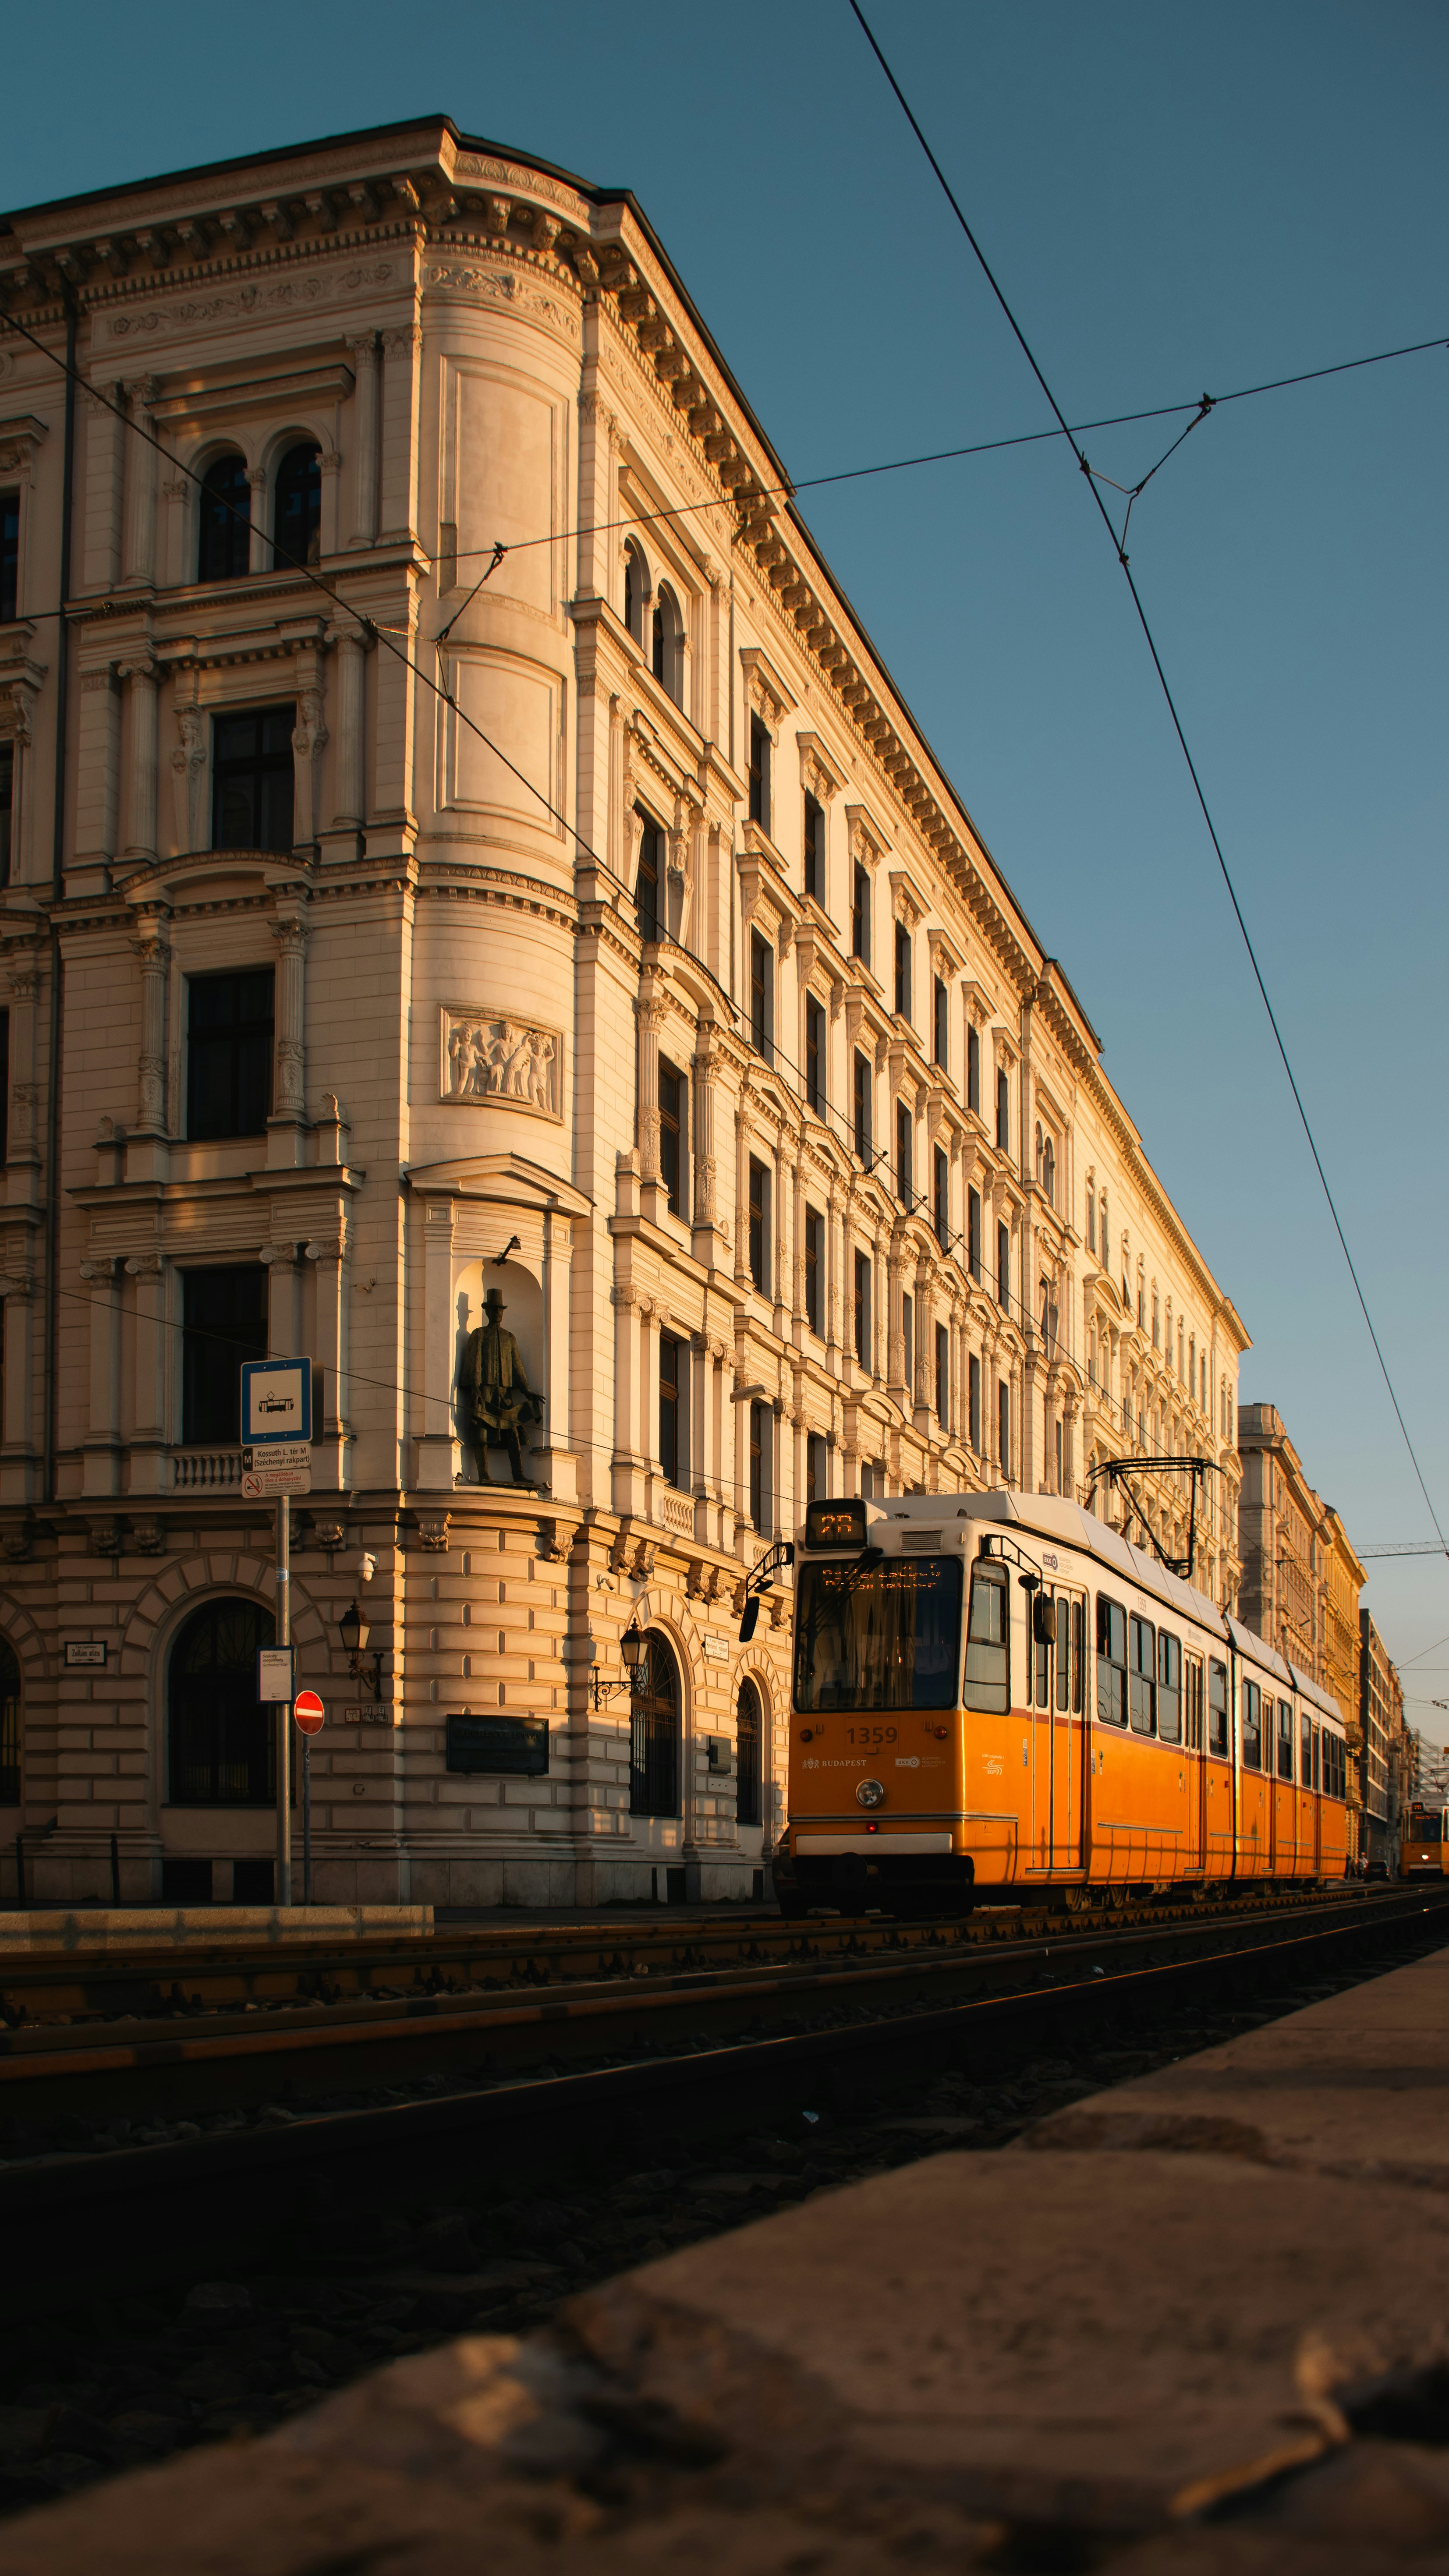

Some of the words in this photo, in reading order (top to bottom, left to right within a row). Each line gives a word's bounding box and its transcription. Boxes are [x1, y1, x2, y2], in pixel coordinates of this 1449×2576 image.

[257, 1449, 281, 1458] Kossuth
[254, 1457, 285, 1467] (Széchenyi
[286, 1455, 310, 1465] rakpart)
[847, 1727, 898, 1744] 1359
